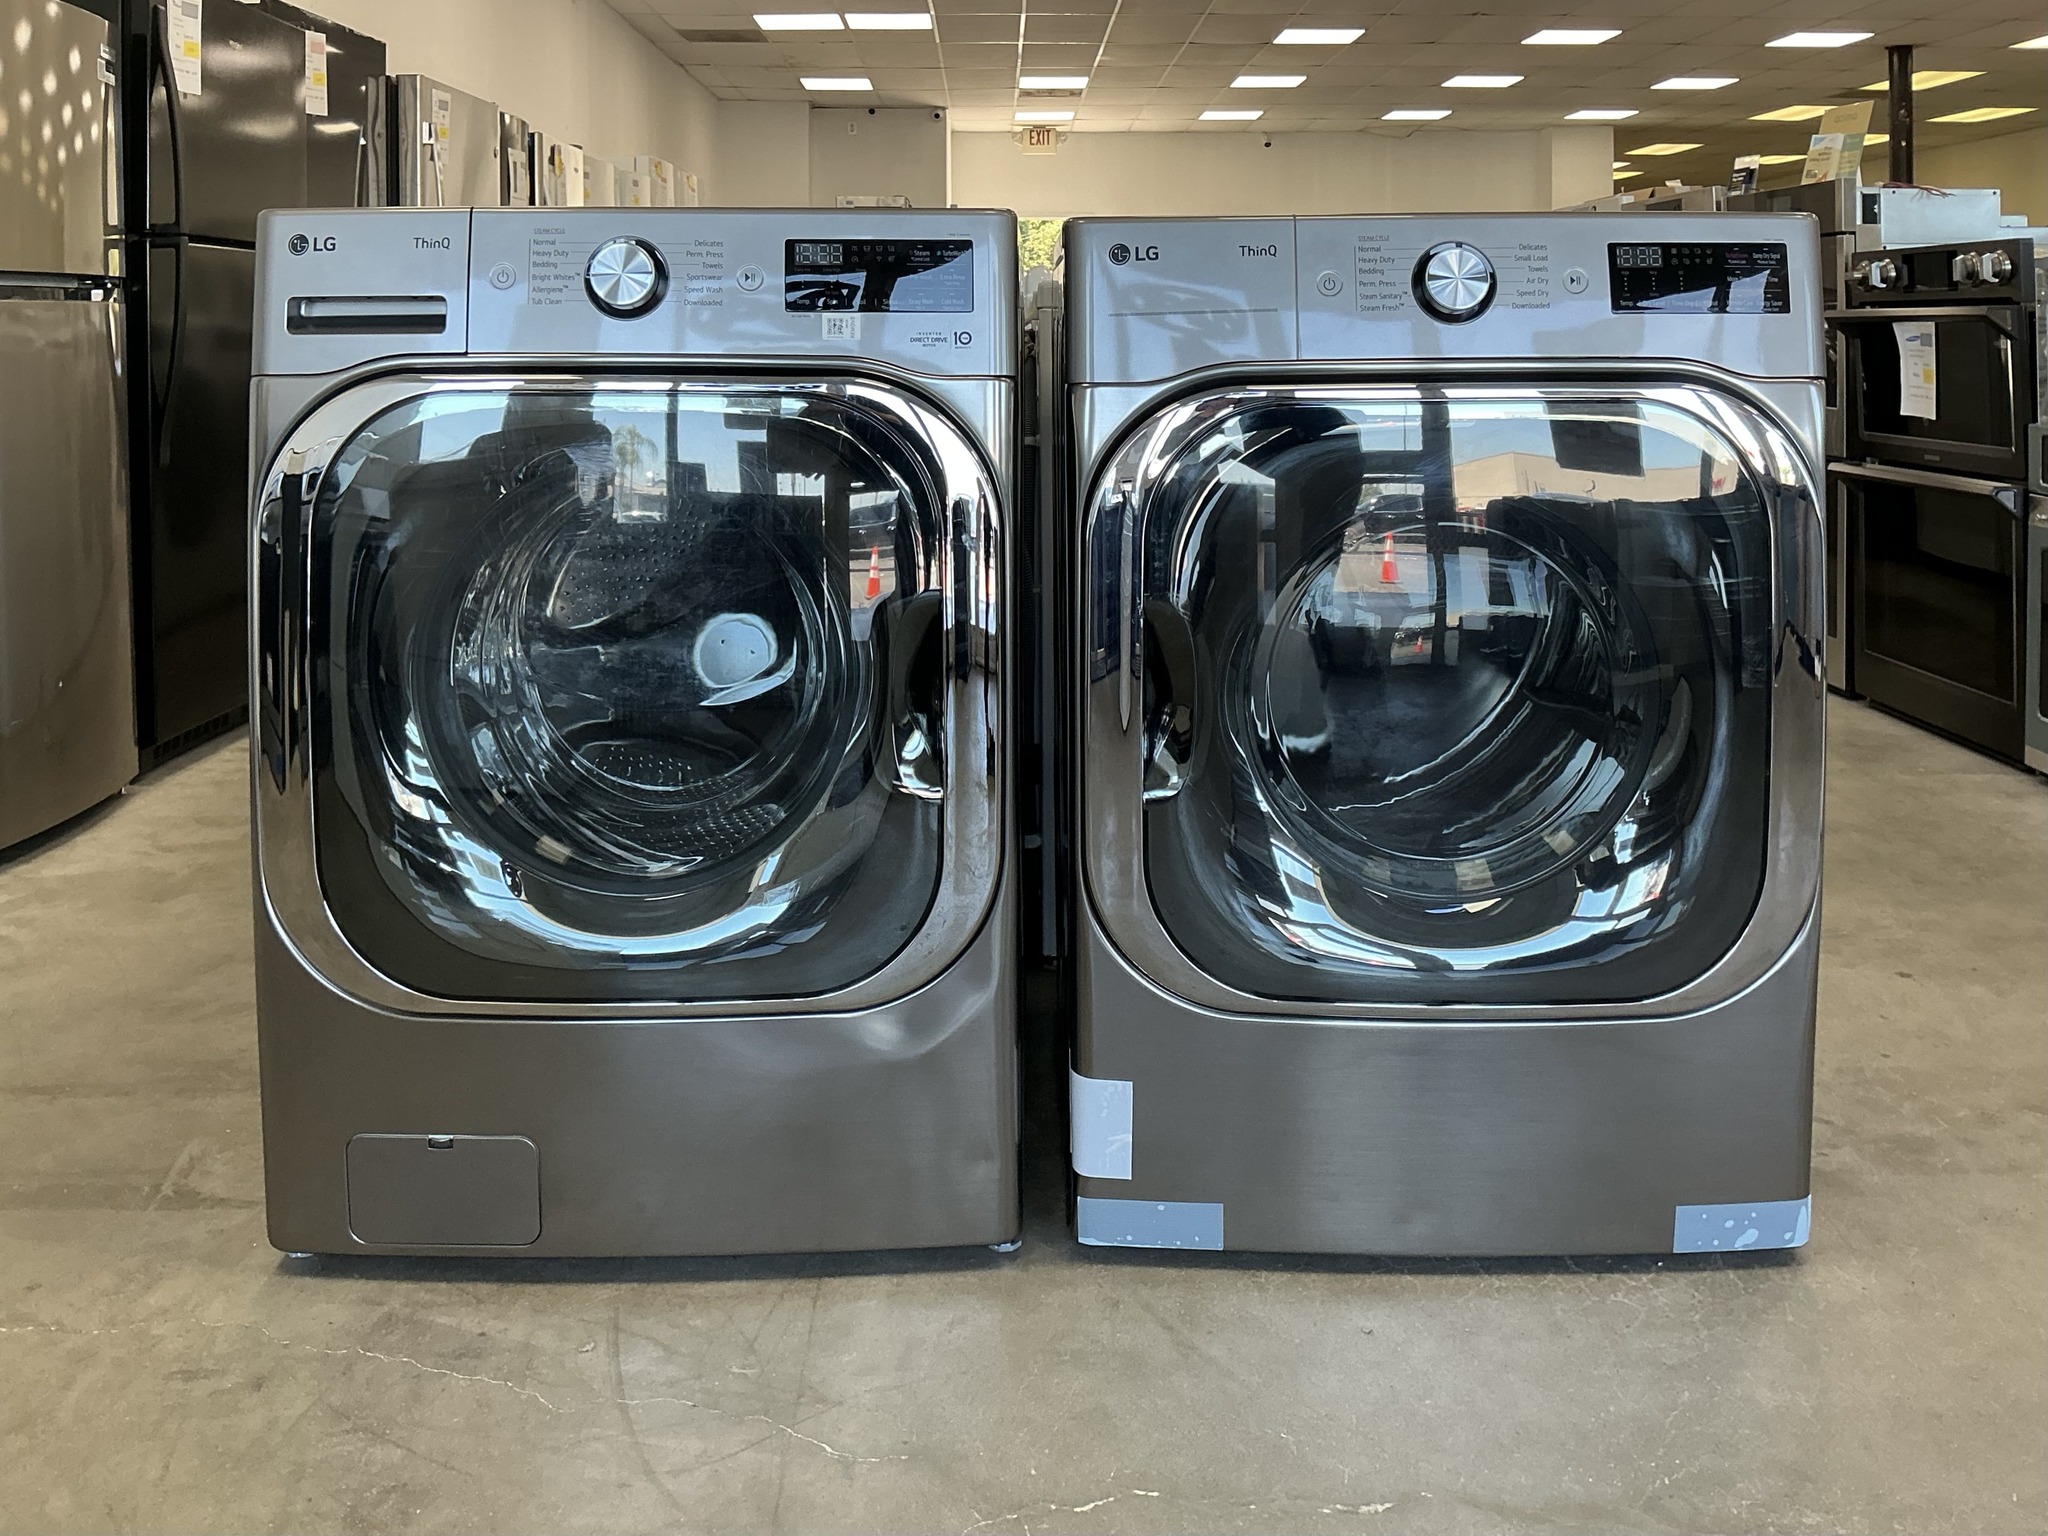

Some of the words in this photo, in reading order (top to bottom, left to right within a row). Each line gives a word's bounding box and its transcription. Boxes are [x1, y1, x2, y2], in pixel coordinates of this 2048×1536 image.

[1029, 129, 1051, 146] EXIT
[313, 237, 336, 252] LG
[413, 237, 450, 250] ThinQ
[554, 250, 569, 258] Duty
[1135, 246, 1159, 261] LG
[1238, 245, 1278, 258] ThinQ
[532, 261, 558, 270] Bedding
[532, 274, 551, 282] Bright
[686, 273, 723, 281] Sportswear
[684, 286, 704, 294] Speed
[1516, 290, 1536, 298] Speed
[1538, 290, 1548, 298] Dry
